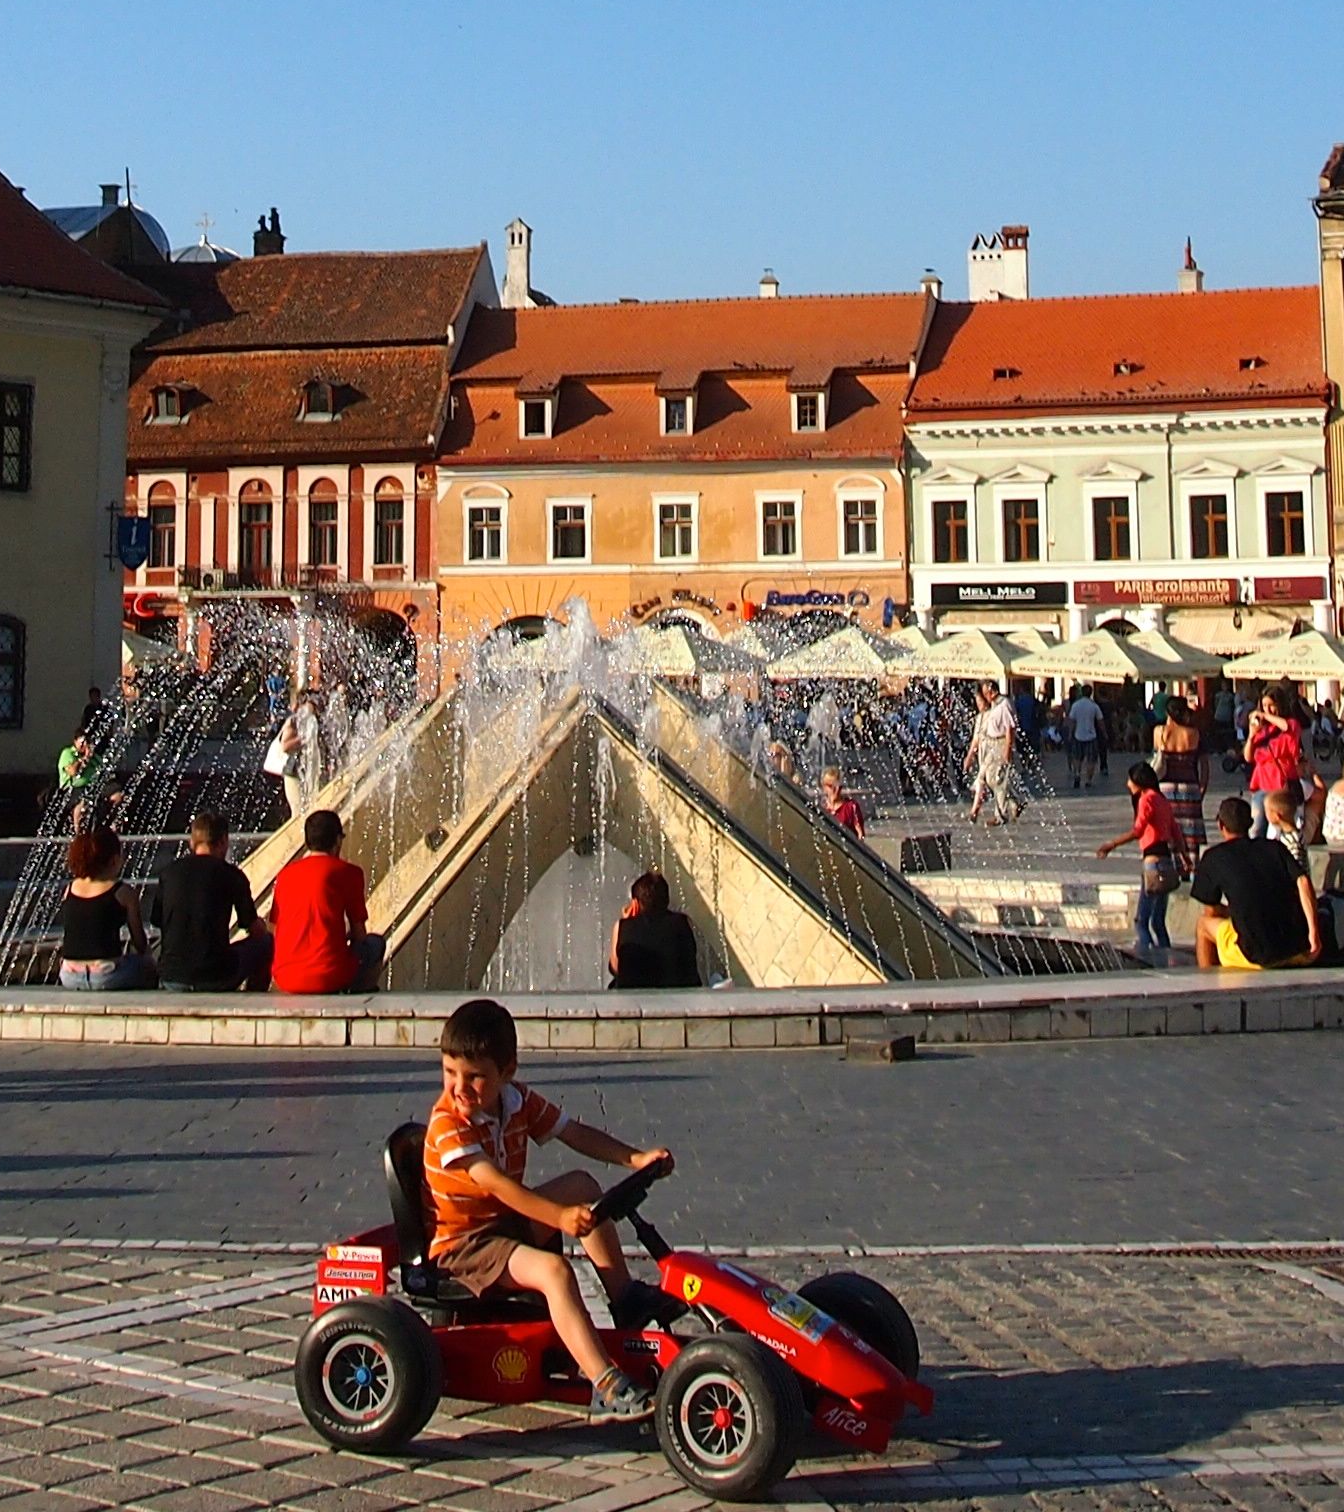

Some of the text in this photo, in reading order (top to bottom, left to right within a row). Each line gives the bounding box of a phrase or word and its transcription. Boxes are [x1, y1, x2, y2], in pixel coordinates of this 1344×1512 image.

[1114, 579, 1153, 594] PARIS
[1155, 578, 1230, 593] croissants
[319, 1287, 357, 1302] AMD
[822, 1406, 868, 1437] Alice
